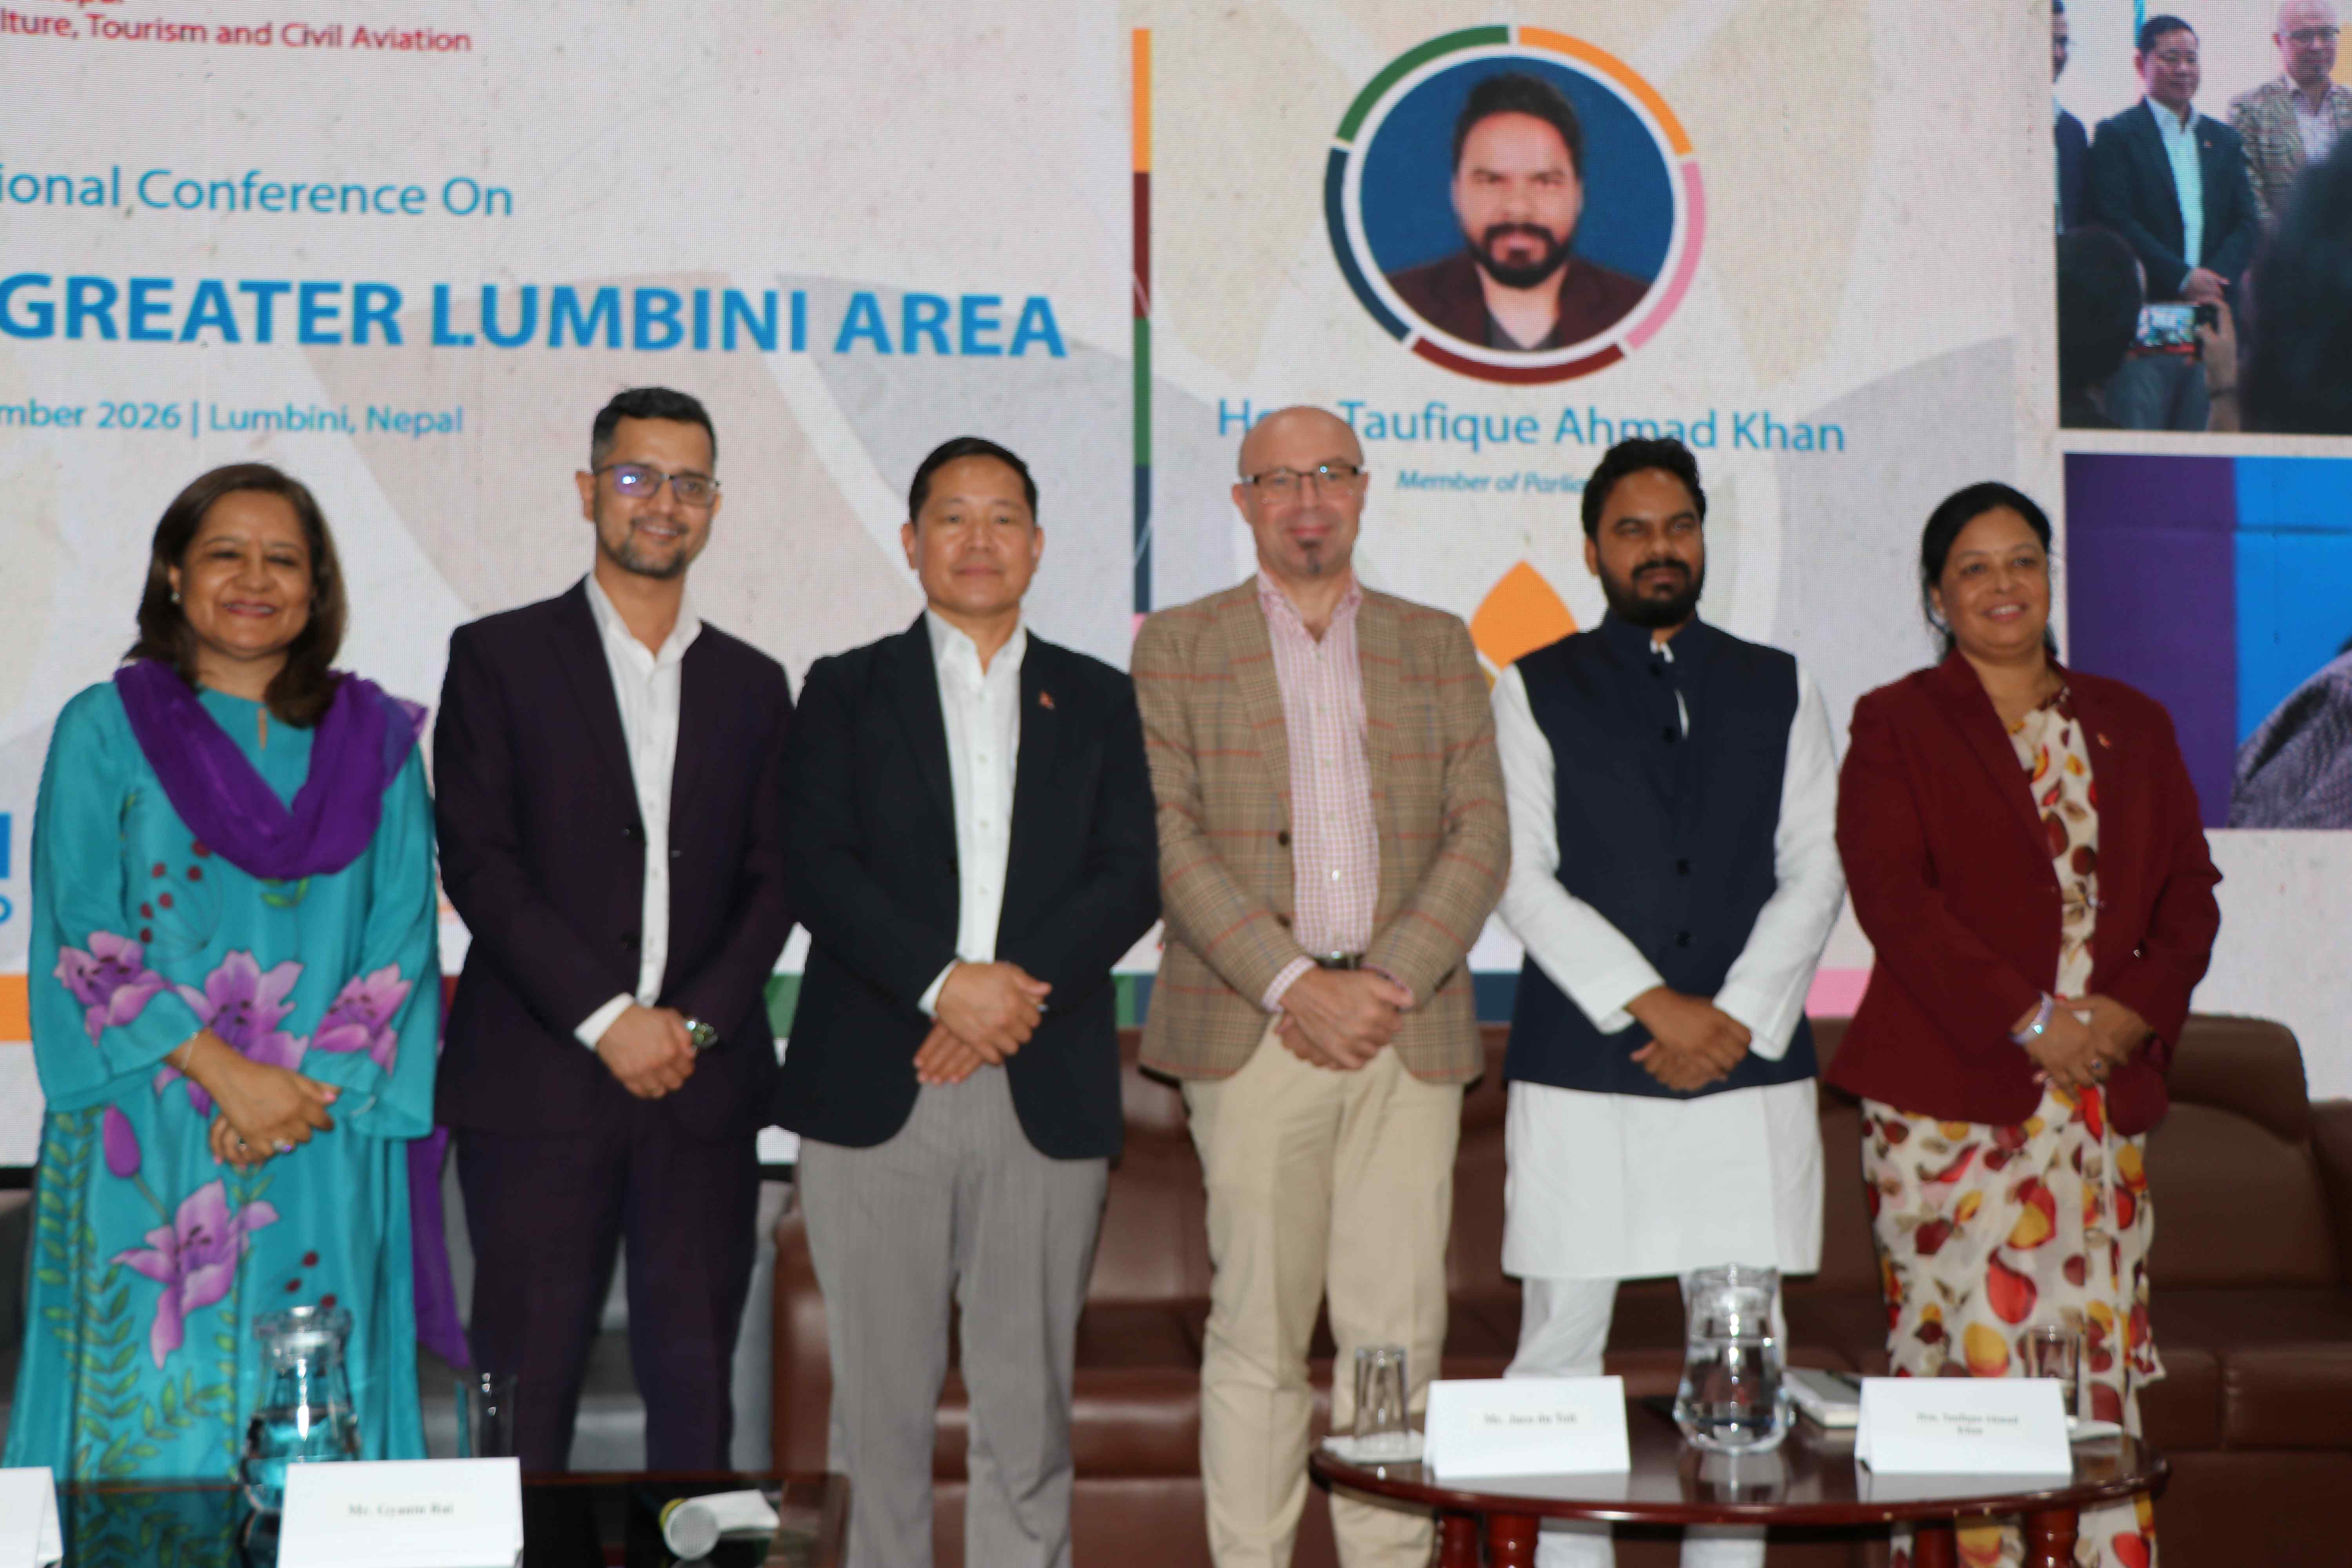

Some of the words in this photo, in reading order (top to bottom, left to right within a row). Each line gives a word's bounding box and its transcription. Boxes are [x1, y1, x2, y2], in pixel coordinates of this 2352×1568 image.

[0, 9, 79, 38] lture,
[84, 12, 209, 43] Tourism
[214, 24, 273, 47] and
[280, 22, 343, 48] Civil
[350, 25, 473, 53] Aviation
[138, 169, 426, 214] Conference
[442, 176, 513, 216] On
[0, 272, 403, 345] GREATER
[432, 282, 808, 352] LUMBINI
[834, 291, 1068, 358] AREA
[0, 397, 86, 428] mber
[97, 400, 181, 430] 2026
[210, 402, 357, 434] Lumbini,
[367, 405, 464, 439] Nepal
[1338, 400, 1541, 452] Taufique
[1555, 406, 1717, 448] Ahmad
[1733, 410, 1845, 451] Khan
[1398, 470, 1489, 491] Member
[1496, 471, 1521, 492] of
